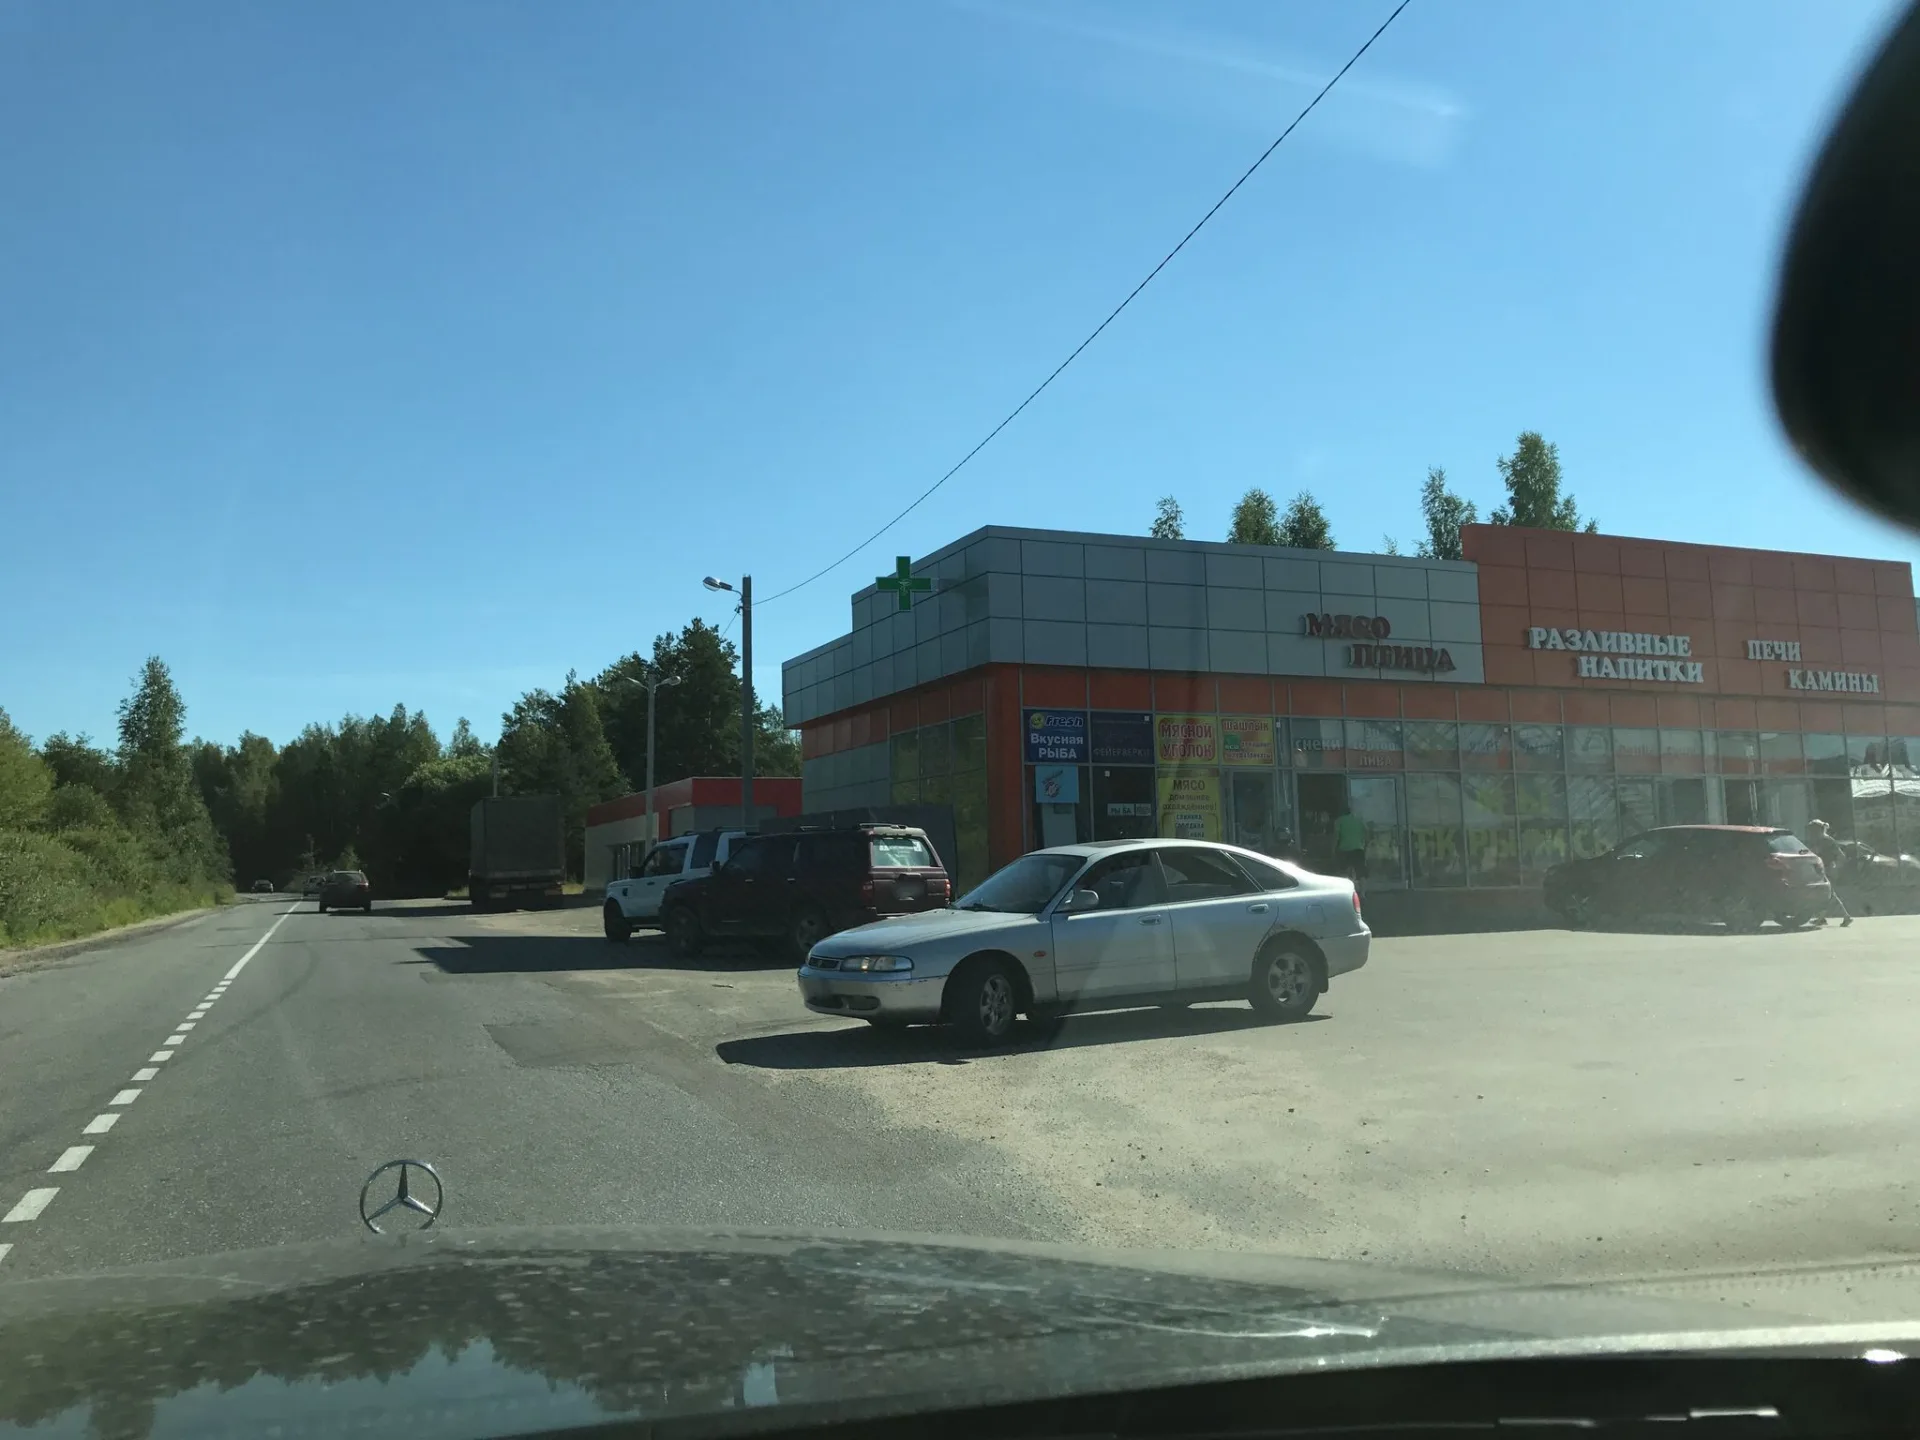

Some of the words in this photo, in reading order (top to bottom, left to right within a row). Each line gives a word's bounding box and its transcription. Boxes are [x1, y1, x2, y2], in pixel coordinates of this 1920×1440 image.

[1301, 613, 1391, 639] МЯСО
[1530, 627, 1693, 657] РАЗЛИВНЫЕ
[1747, 639, 1802, 662] ПЕЧИ
[1348, 644, 1457, 674] ПТИЦА
[1577, 656, 1705, 683] НАПИТКИ
[1788, 669, 1880, 694] КАМИНЫ
[1045, 715, 1084, 727] Fresh
[1030, 733, 1084, 746] Вкусная
[1163, 743, 1213, 758] УГОЛОК
[1038, 747, 1078, 759] РЫБА
[1172, 780, 1206, 790] МЯСО
